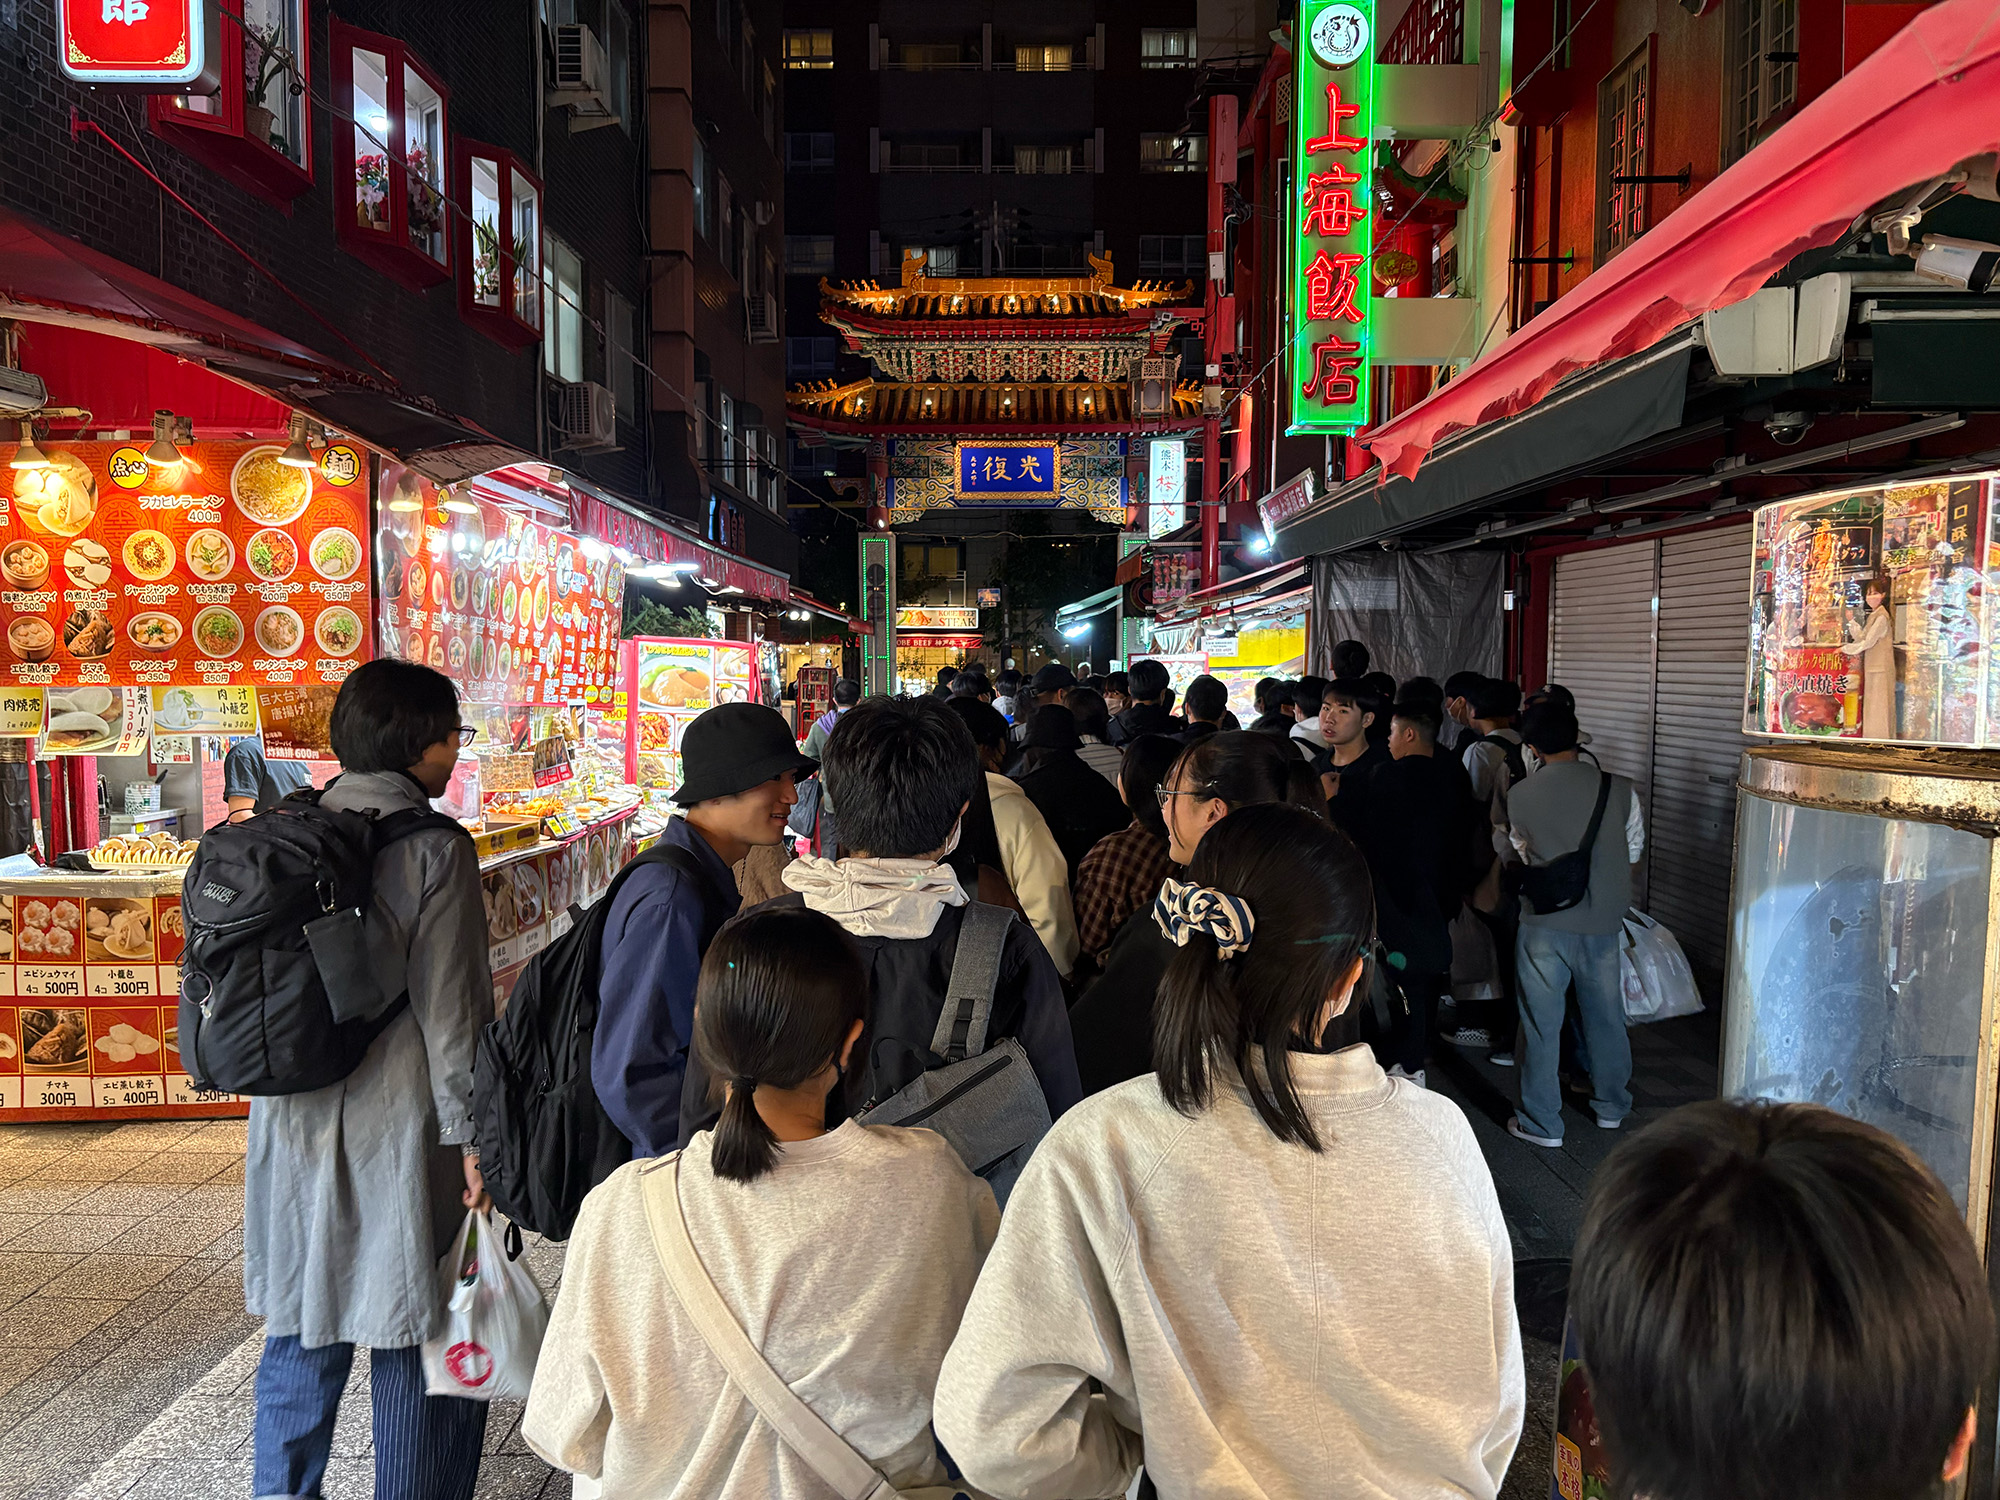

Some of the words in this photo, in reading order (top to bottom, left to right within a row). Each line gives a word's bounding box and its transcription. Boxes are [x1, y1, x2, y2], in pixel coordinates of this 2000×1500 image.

[1303, 82, 1368, 406] 上海飯店
[112, 457, 148, 477] 点心
[139, 496, 224, 509] フカヒレラーメン
[188, 510, 221, 522] 400円
[125, 585, 178, 595] ジャージャンメン
[187, 584, 237, 595] もちもち水餃子
[310, 582, 365, 592] チャーシューメン
[139, 595, 165, 603] 400円
[262, 592, 287, 601] 400円
[325, 591, 351, 600] 350円
[939, 617, 976, 627] STEAK
[81, 663, 106, 673] チマキ
[130, 660, 177, 670] ワンタンスープ
[253, 660, 307, 669] ワンタンラーメン
[203, 673, 229, 682] 350円
[266, 672, 292, 681] 400円
[3, 699, 40, 712] 肉焼売
[23, 970, 76, 979] エビシュウマイ
[45, 982, 79, 995] 500円
[114, 981, 149, 995] 300円
[46, 1081, 70, 1089] チマキ
[103, 1079, 154, 1090] エビ蒸し餃子
[40, 1092, 76, 1106] 300円
[123, 1091, 158, 1104] 400円
[195, 1091, 230, 1102] 250円
